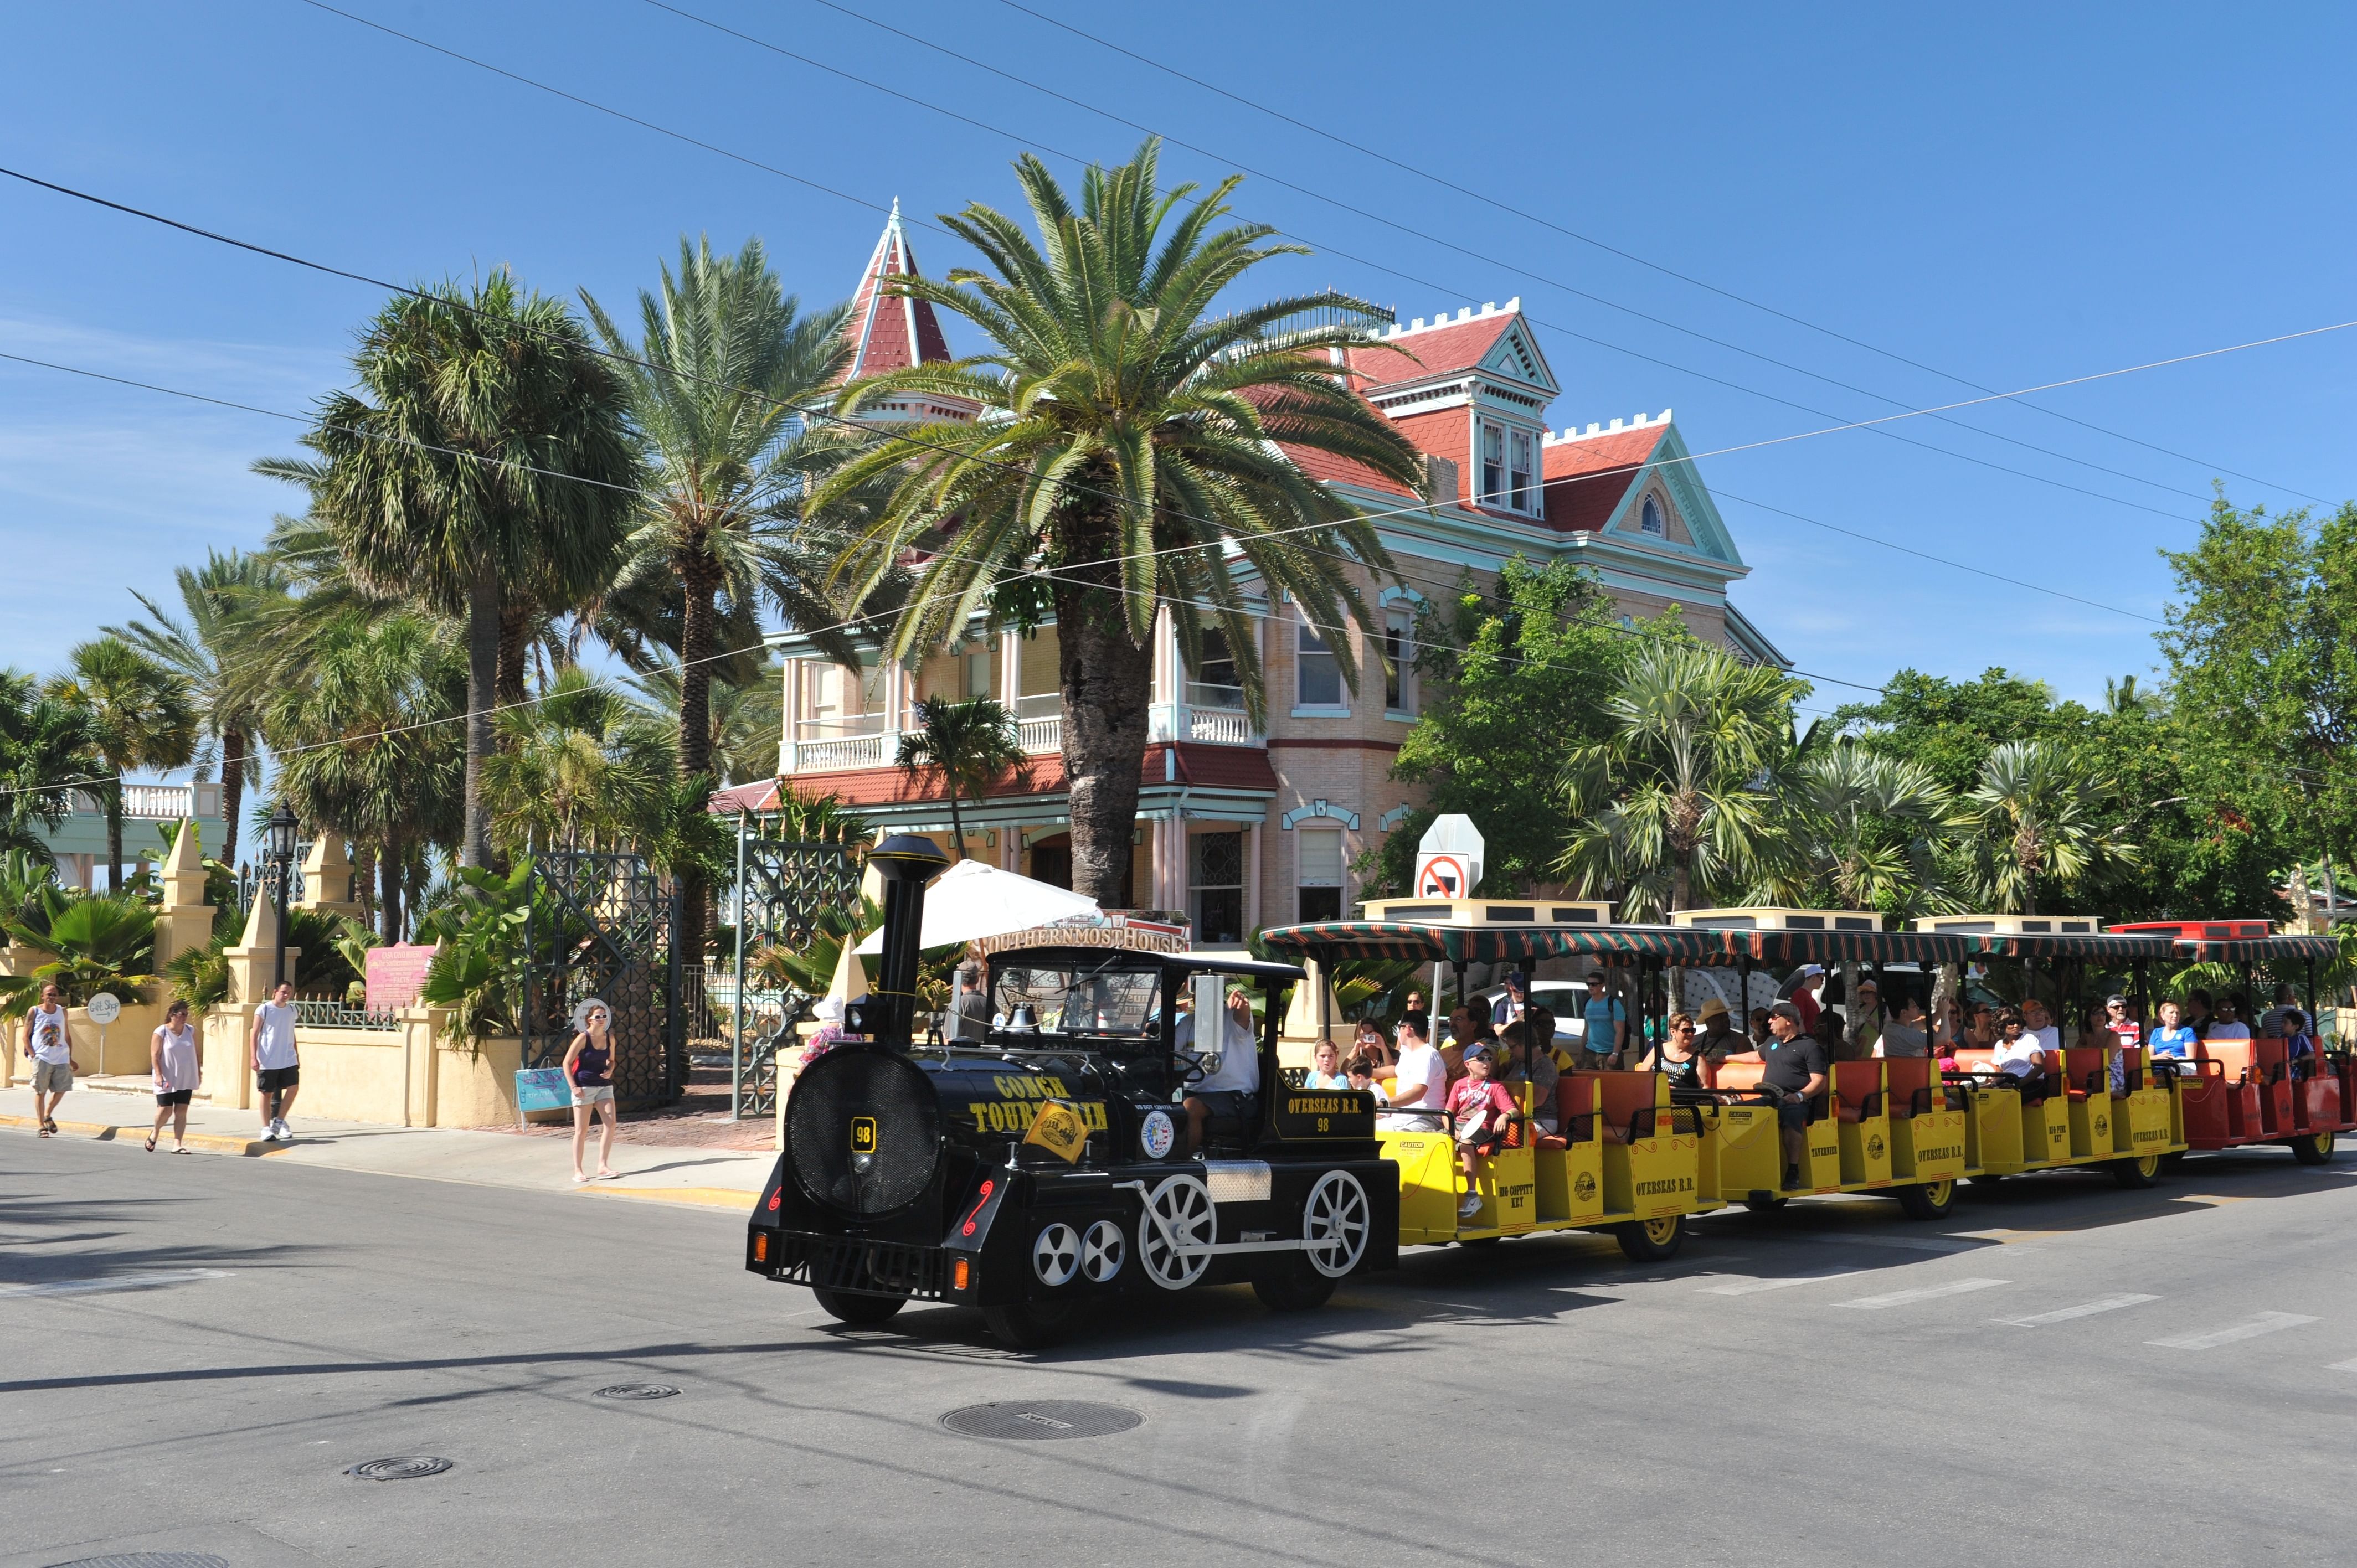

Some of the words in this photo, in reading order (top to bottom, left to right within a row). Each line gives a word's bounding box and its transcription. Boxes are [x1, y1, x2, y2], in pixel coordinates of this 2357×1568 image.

[1121, 926, 1186, 953] HOUSE
[993, 1075, 1071, 1099] CONCH
[1288, 1098, 1339, 1114] OVERSEAS
[1342, 1098, 1362, 1113] R.R.
[1318, 1117, 1329, 1132] 98
[857, 1126, 871, 1143] 98
[1812, 1146, 1838, 1157] TAVERNIER
[1918, 1147, 1950, 1162] OVERSEAS
[1951, 1145, 1964, 1158] R.R.
[1636, 1179, 1676, 1196] OVERSEAS
[1679, 1177, 1695, 1192] R.R.
[1511, 1196, 1524, 1208] KEY
